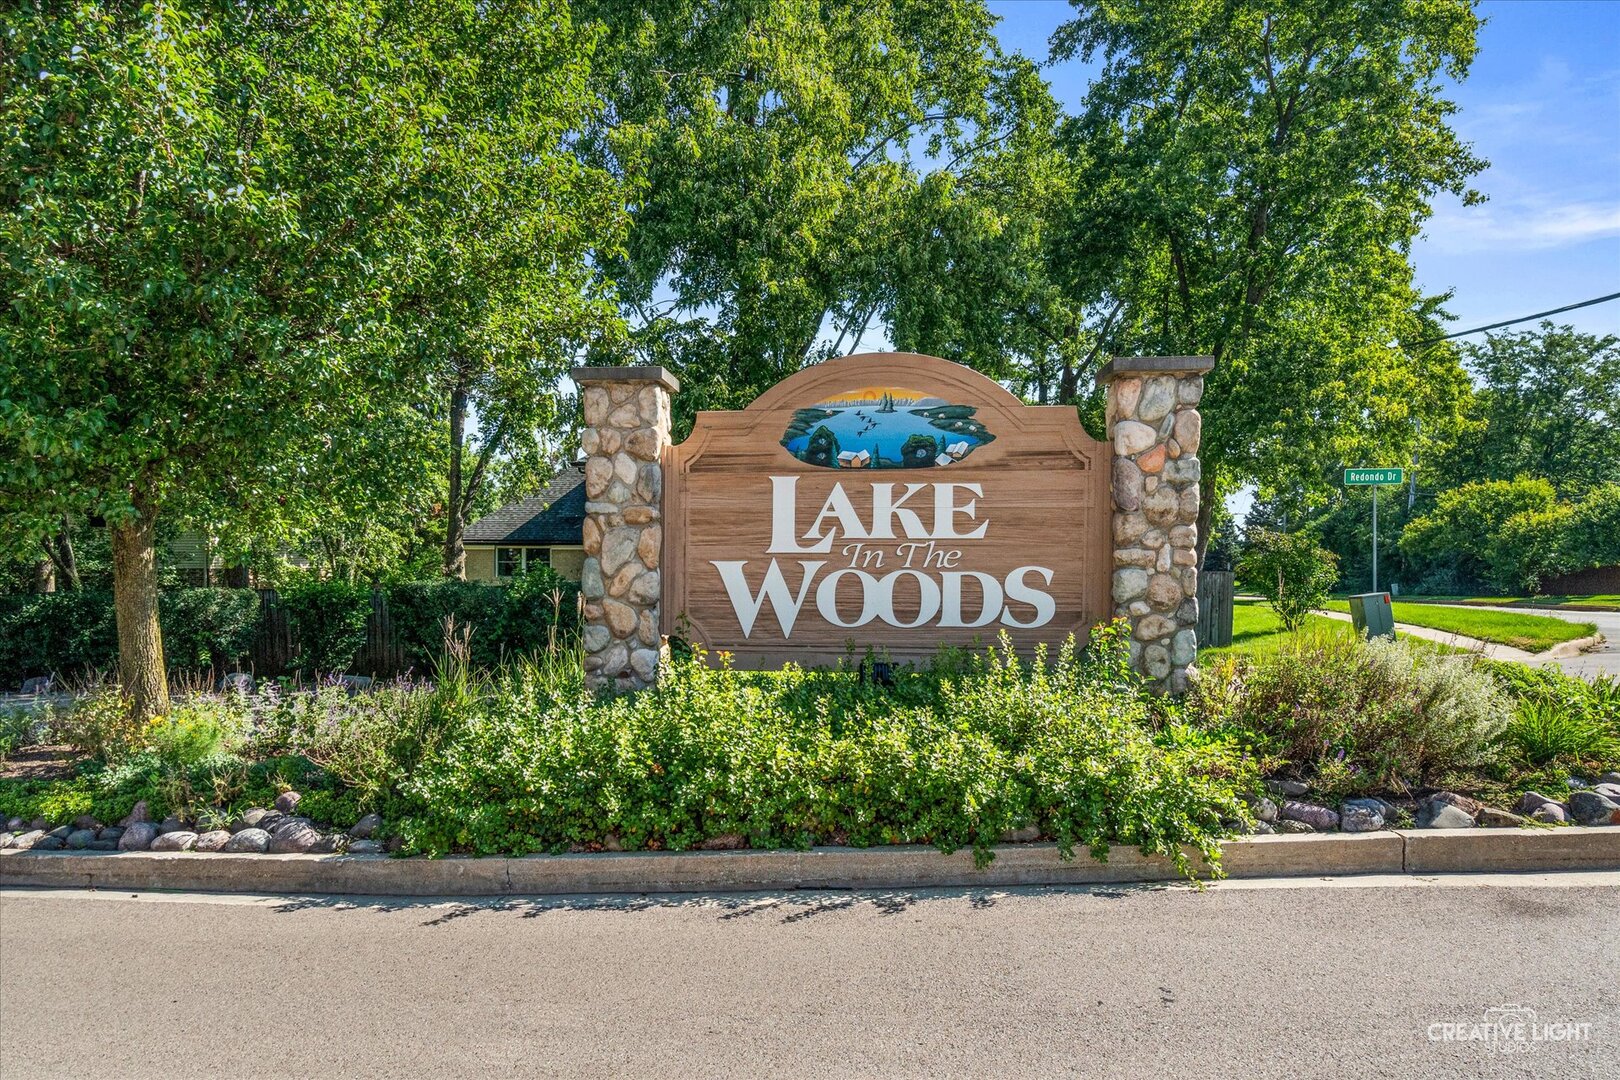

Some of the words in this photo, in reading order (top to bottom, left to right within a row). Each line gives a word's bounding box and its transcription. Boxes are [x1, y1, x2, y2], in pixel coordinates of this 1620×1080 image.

[1350, 472, 1384, 481] Redondo
[1387, 471, 1397, 481] Dr
[766, 476, 989, 553] LAKE
[843, 543, 884, 568] In
[896, 541, 962, 568] The
[709, 557, 1056, 639] WOODS
